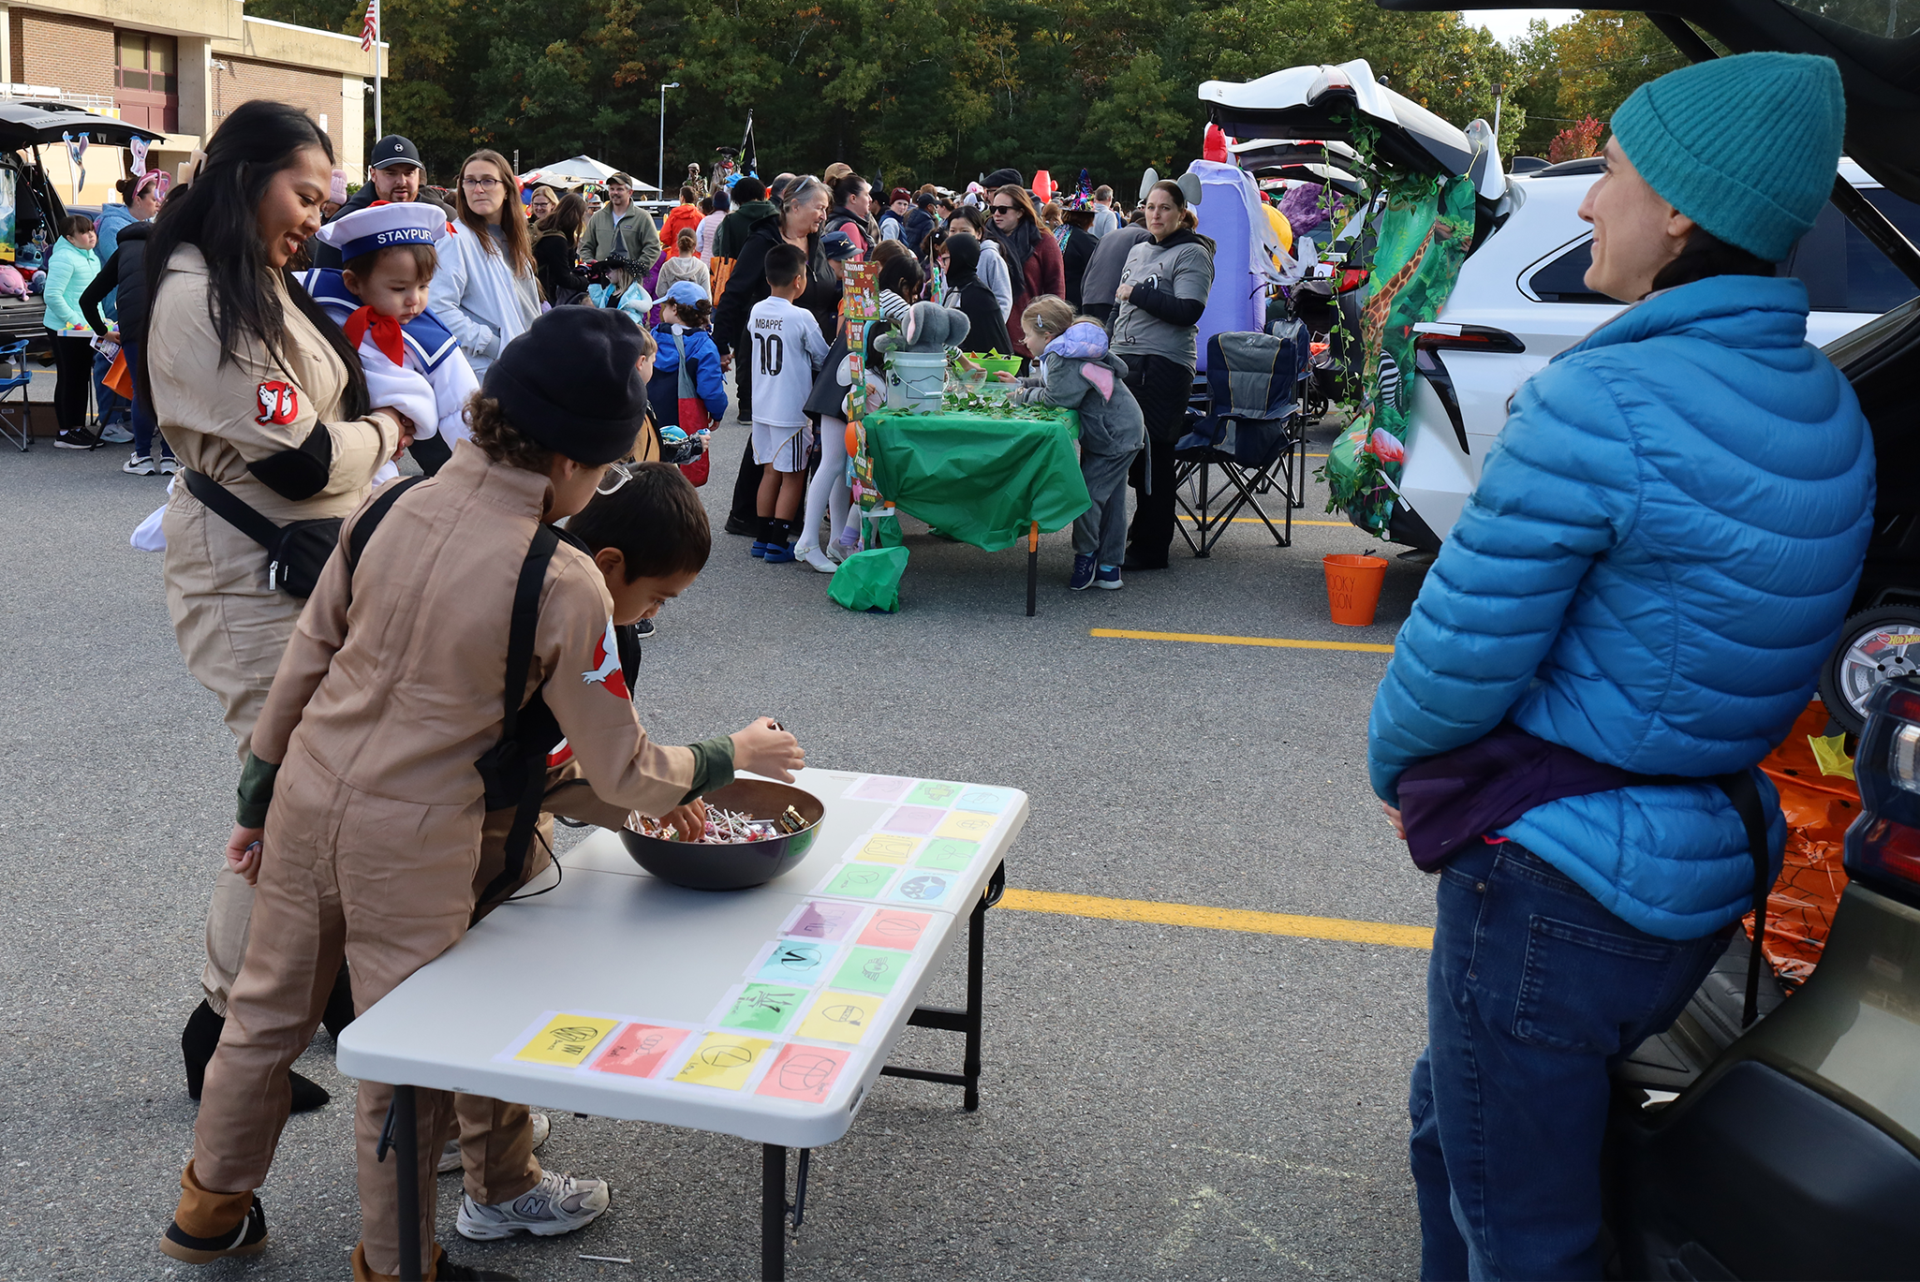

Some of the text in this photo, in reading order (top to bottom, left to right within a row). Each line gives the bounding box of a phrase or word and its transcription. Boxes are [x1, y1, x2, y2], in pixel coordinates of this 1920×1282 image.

[755, 317, 783, 330] MBAPPÉ
[754, 332, 783, 376] 10
[1326, 573, 1355, 592] OOKY
[1888, 634, 1905, 645] HOT
[521, 1197, 545, 1215] N
